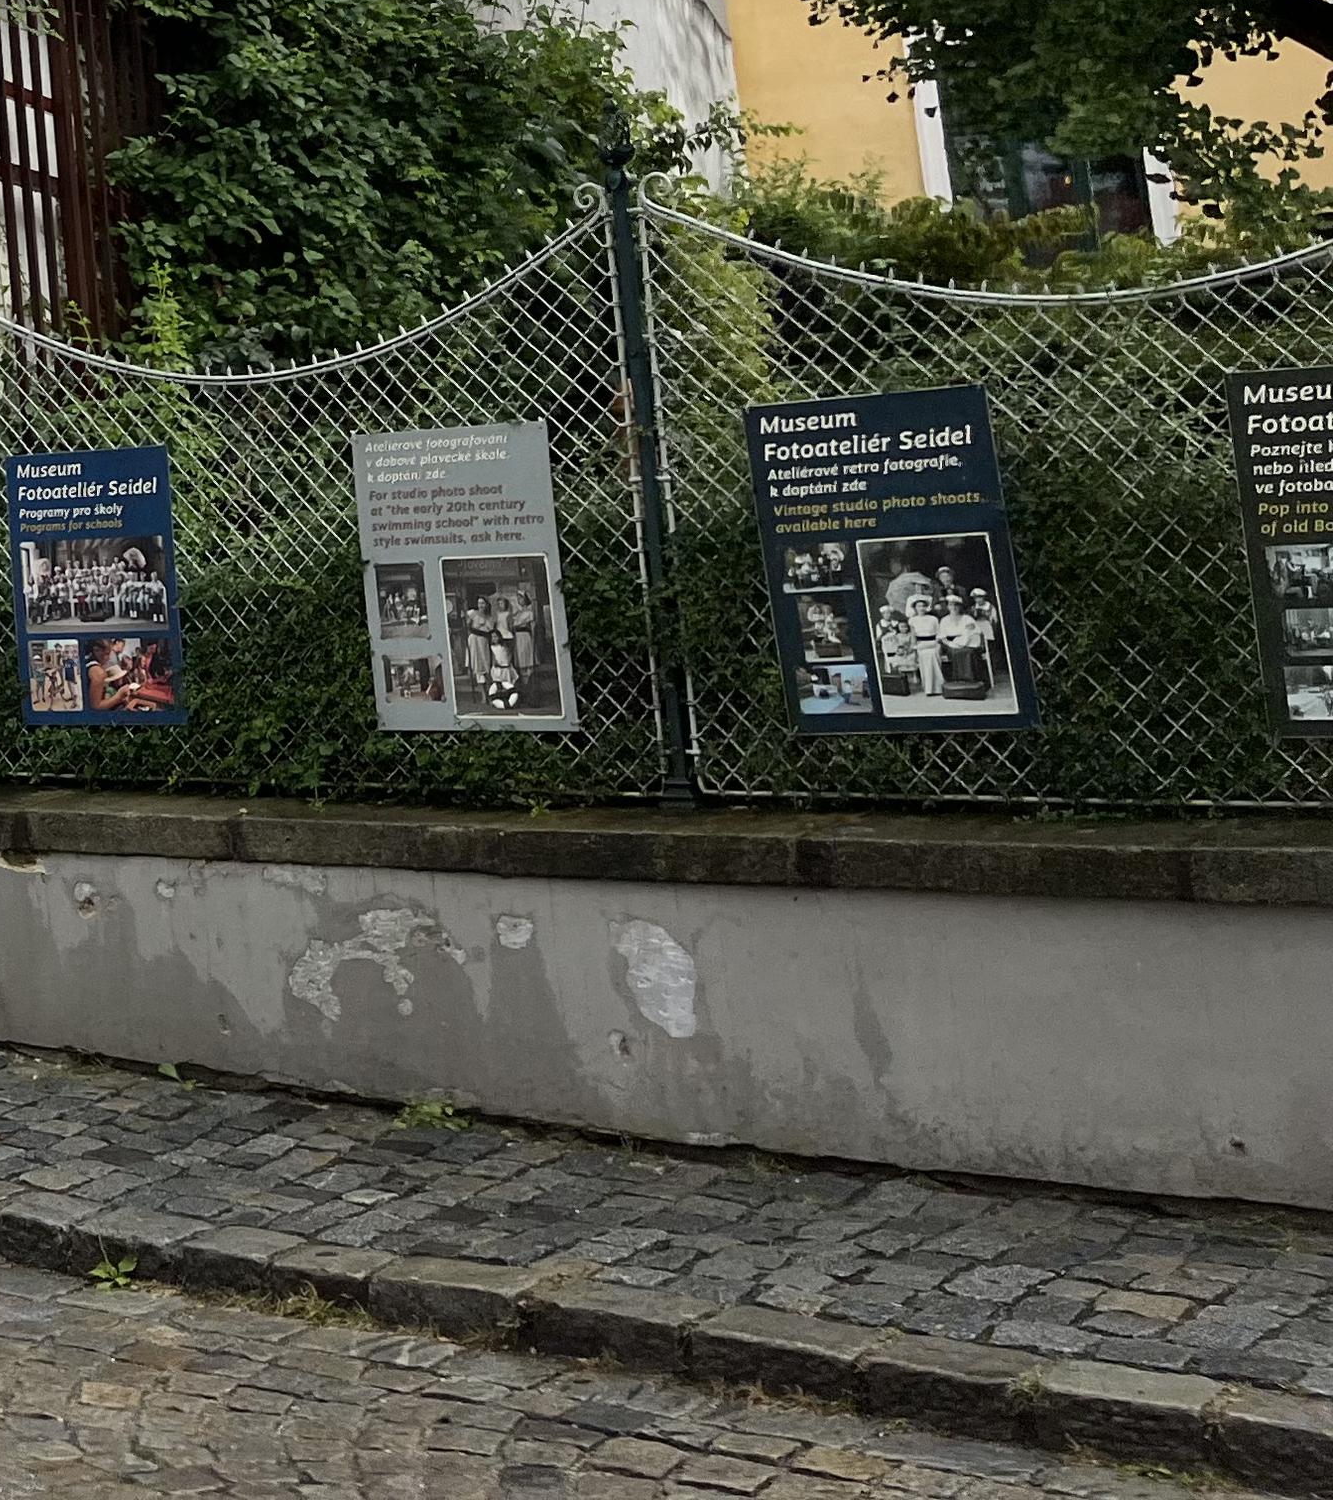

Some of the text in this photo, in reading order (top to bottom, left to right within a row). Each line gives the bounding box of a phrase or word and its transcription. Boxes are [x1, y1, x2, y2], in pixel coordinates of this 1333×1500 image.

[760, 411, 857, 435] Museum
[764, 424, 972, 462] Fotoateliér Seidel
[1250, 440, 1323, 458] Poznejte
[16, 463, 82, 479] Museum
[366, 459, 373, 468] v
[767, 463, 839, 482] Ateliérové
[843, 462, 879, 475] retro
[1253, 461, 1294, 476] nebo
[367, 473, 374, 483] k
[425, 469, 446, 480] zde
[18, 477, 158, 501] Fotoateliér Seidel
[369, 484, 503, 503] For studio photo shoot
[770, 485, 779, 498] k
[842, 479, 867, 493] zde
[1255, 482, 1274, 494] ve
[19, 503, 123, 521] Programy pro školy
[370, 505, 383, 516] at
[413, 502, 444, 516] early
[446, 501, 475, 513] 20th
[478, 499, 526, 513] century
[774, 503, 828, 517] Vintage
[832, 499, 878, 514] studio
[883, 496, 925, 511] photo
[1258, 500, 1329, 517] Pop into
[20, 518, 123, 535] Programs for schools
[371, 518, 432, 532] swimming
[483, 514, 510, 526] with
[514, 514, 545, 526] retro
[776, 516, 877, 534] available here
[1261, 520, 1277, 537] of
[1283, 519, 1309, 533] old
[373, 531, 525, 549] style swimsuits, ask here.
